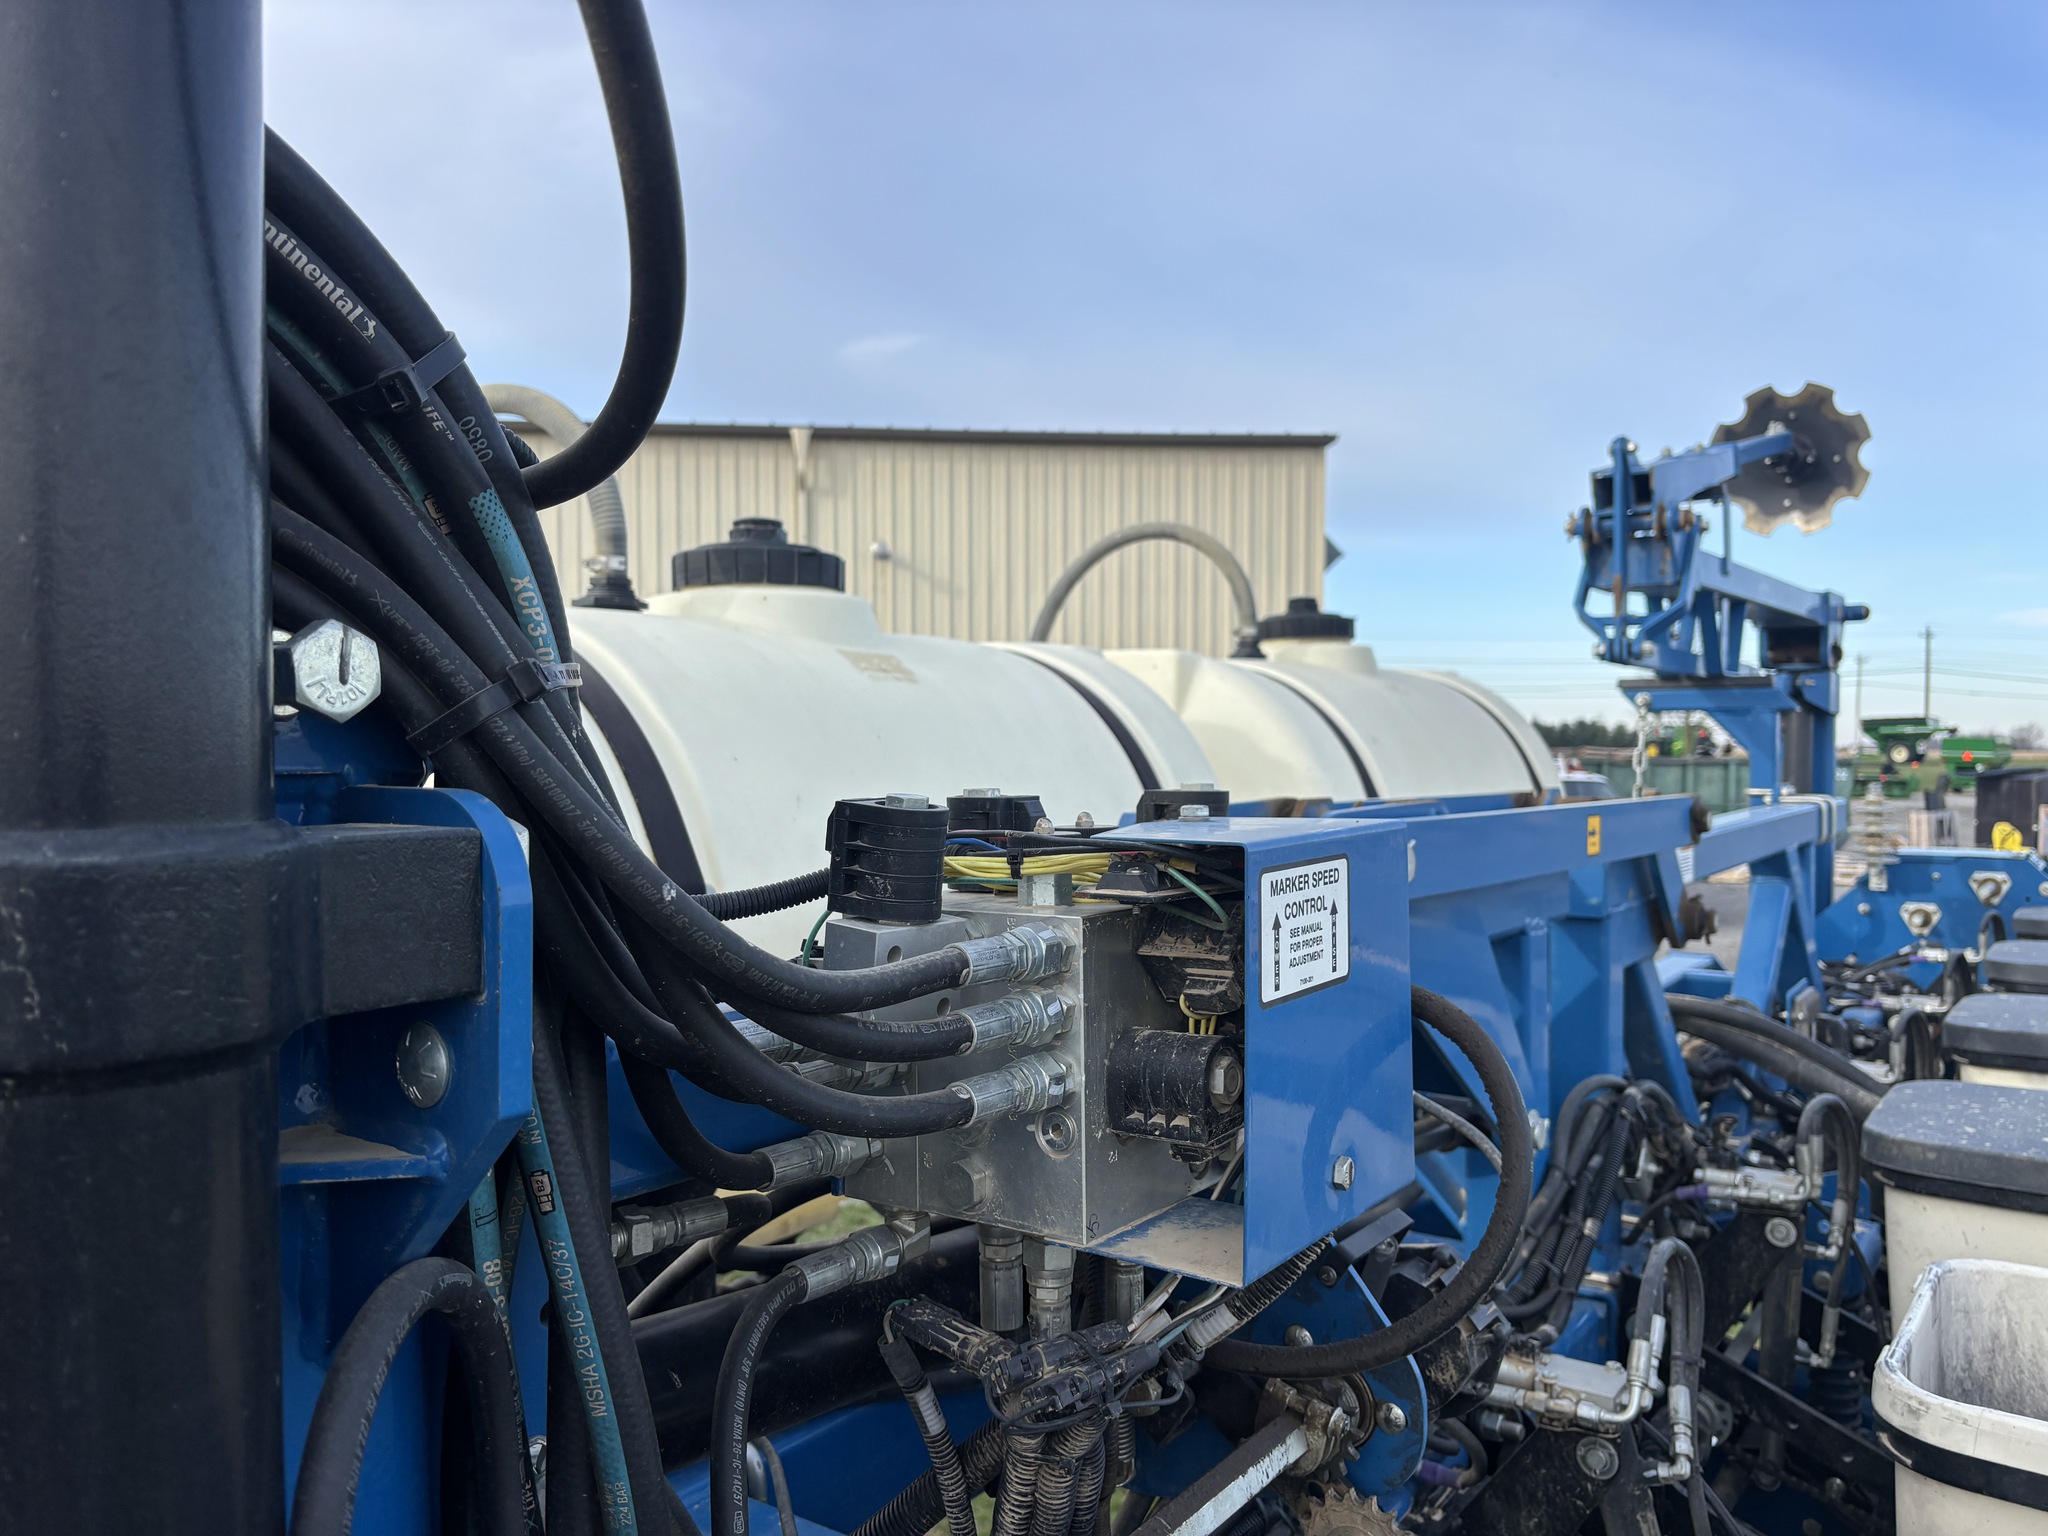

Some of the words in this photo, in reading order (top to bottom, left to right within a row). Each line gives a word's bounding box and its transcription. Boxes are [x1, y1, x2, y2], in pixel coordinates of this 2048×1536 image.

[264, 218, 363, 325] ntinental
[509, 575, 558, 668] XCP3-0
[1270, 873, 1311, 897] MARKER
[1311, 868, 1340, 888] SPEED
[1284, 895, 1328, 920] CONTROL
[1289, 927, 1301, 939] SEE
[1301, 921, 1323, 935] MANUAL
[1289, 941, 1301, 954] FOR
[1302, 935, 1324, 949] PROPER
[1289, 949, 1324, 969] ADJUSTMENT
[536, 1178, 545, 1194] B2
[547, 1239, 599, 1361] 2G-IC-14C/37
[587, 1361, 609, 1418] MSHA
[733, 1415, 744, 1443] MSHA
[613, 1481, 627, 1505] BAR
[620, 1504, 634, 1527] 224
